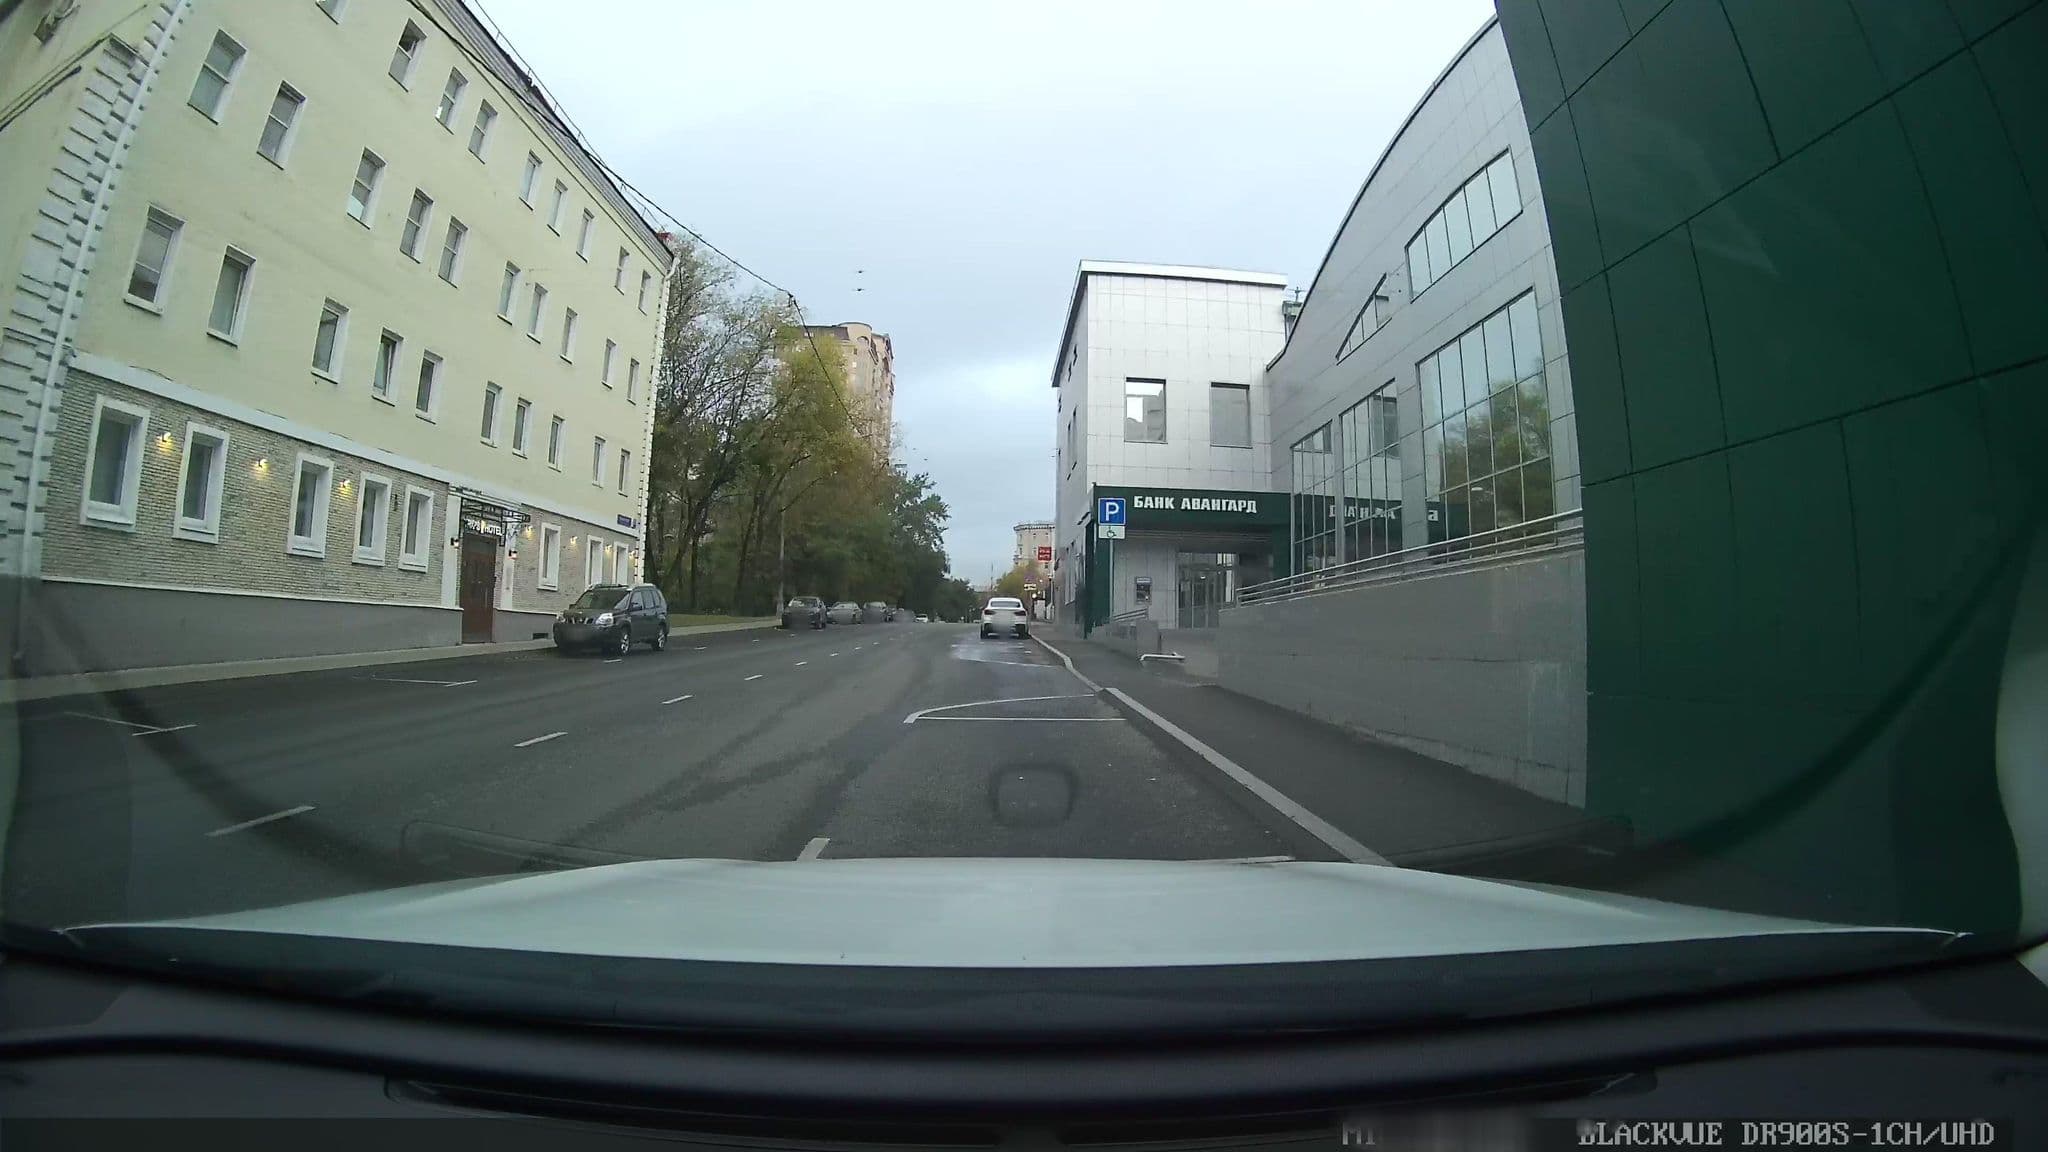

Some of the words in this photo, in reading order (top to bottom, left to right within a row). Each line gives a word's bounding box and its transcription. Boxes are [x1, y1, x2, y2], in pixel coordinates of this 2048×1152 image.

[1105, 502, 1119, 521] P
[1133, 495, 1175, 510] БАНК
[1180, 497, 1257, 513] АВАНГАРД
